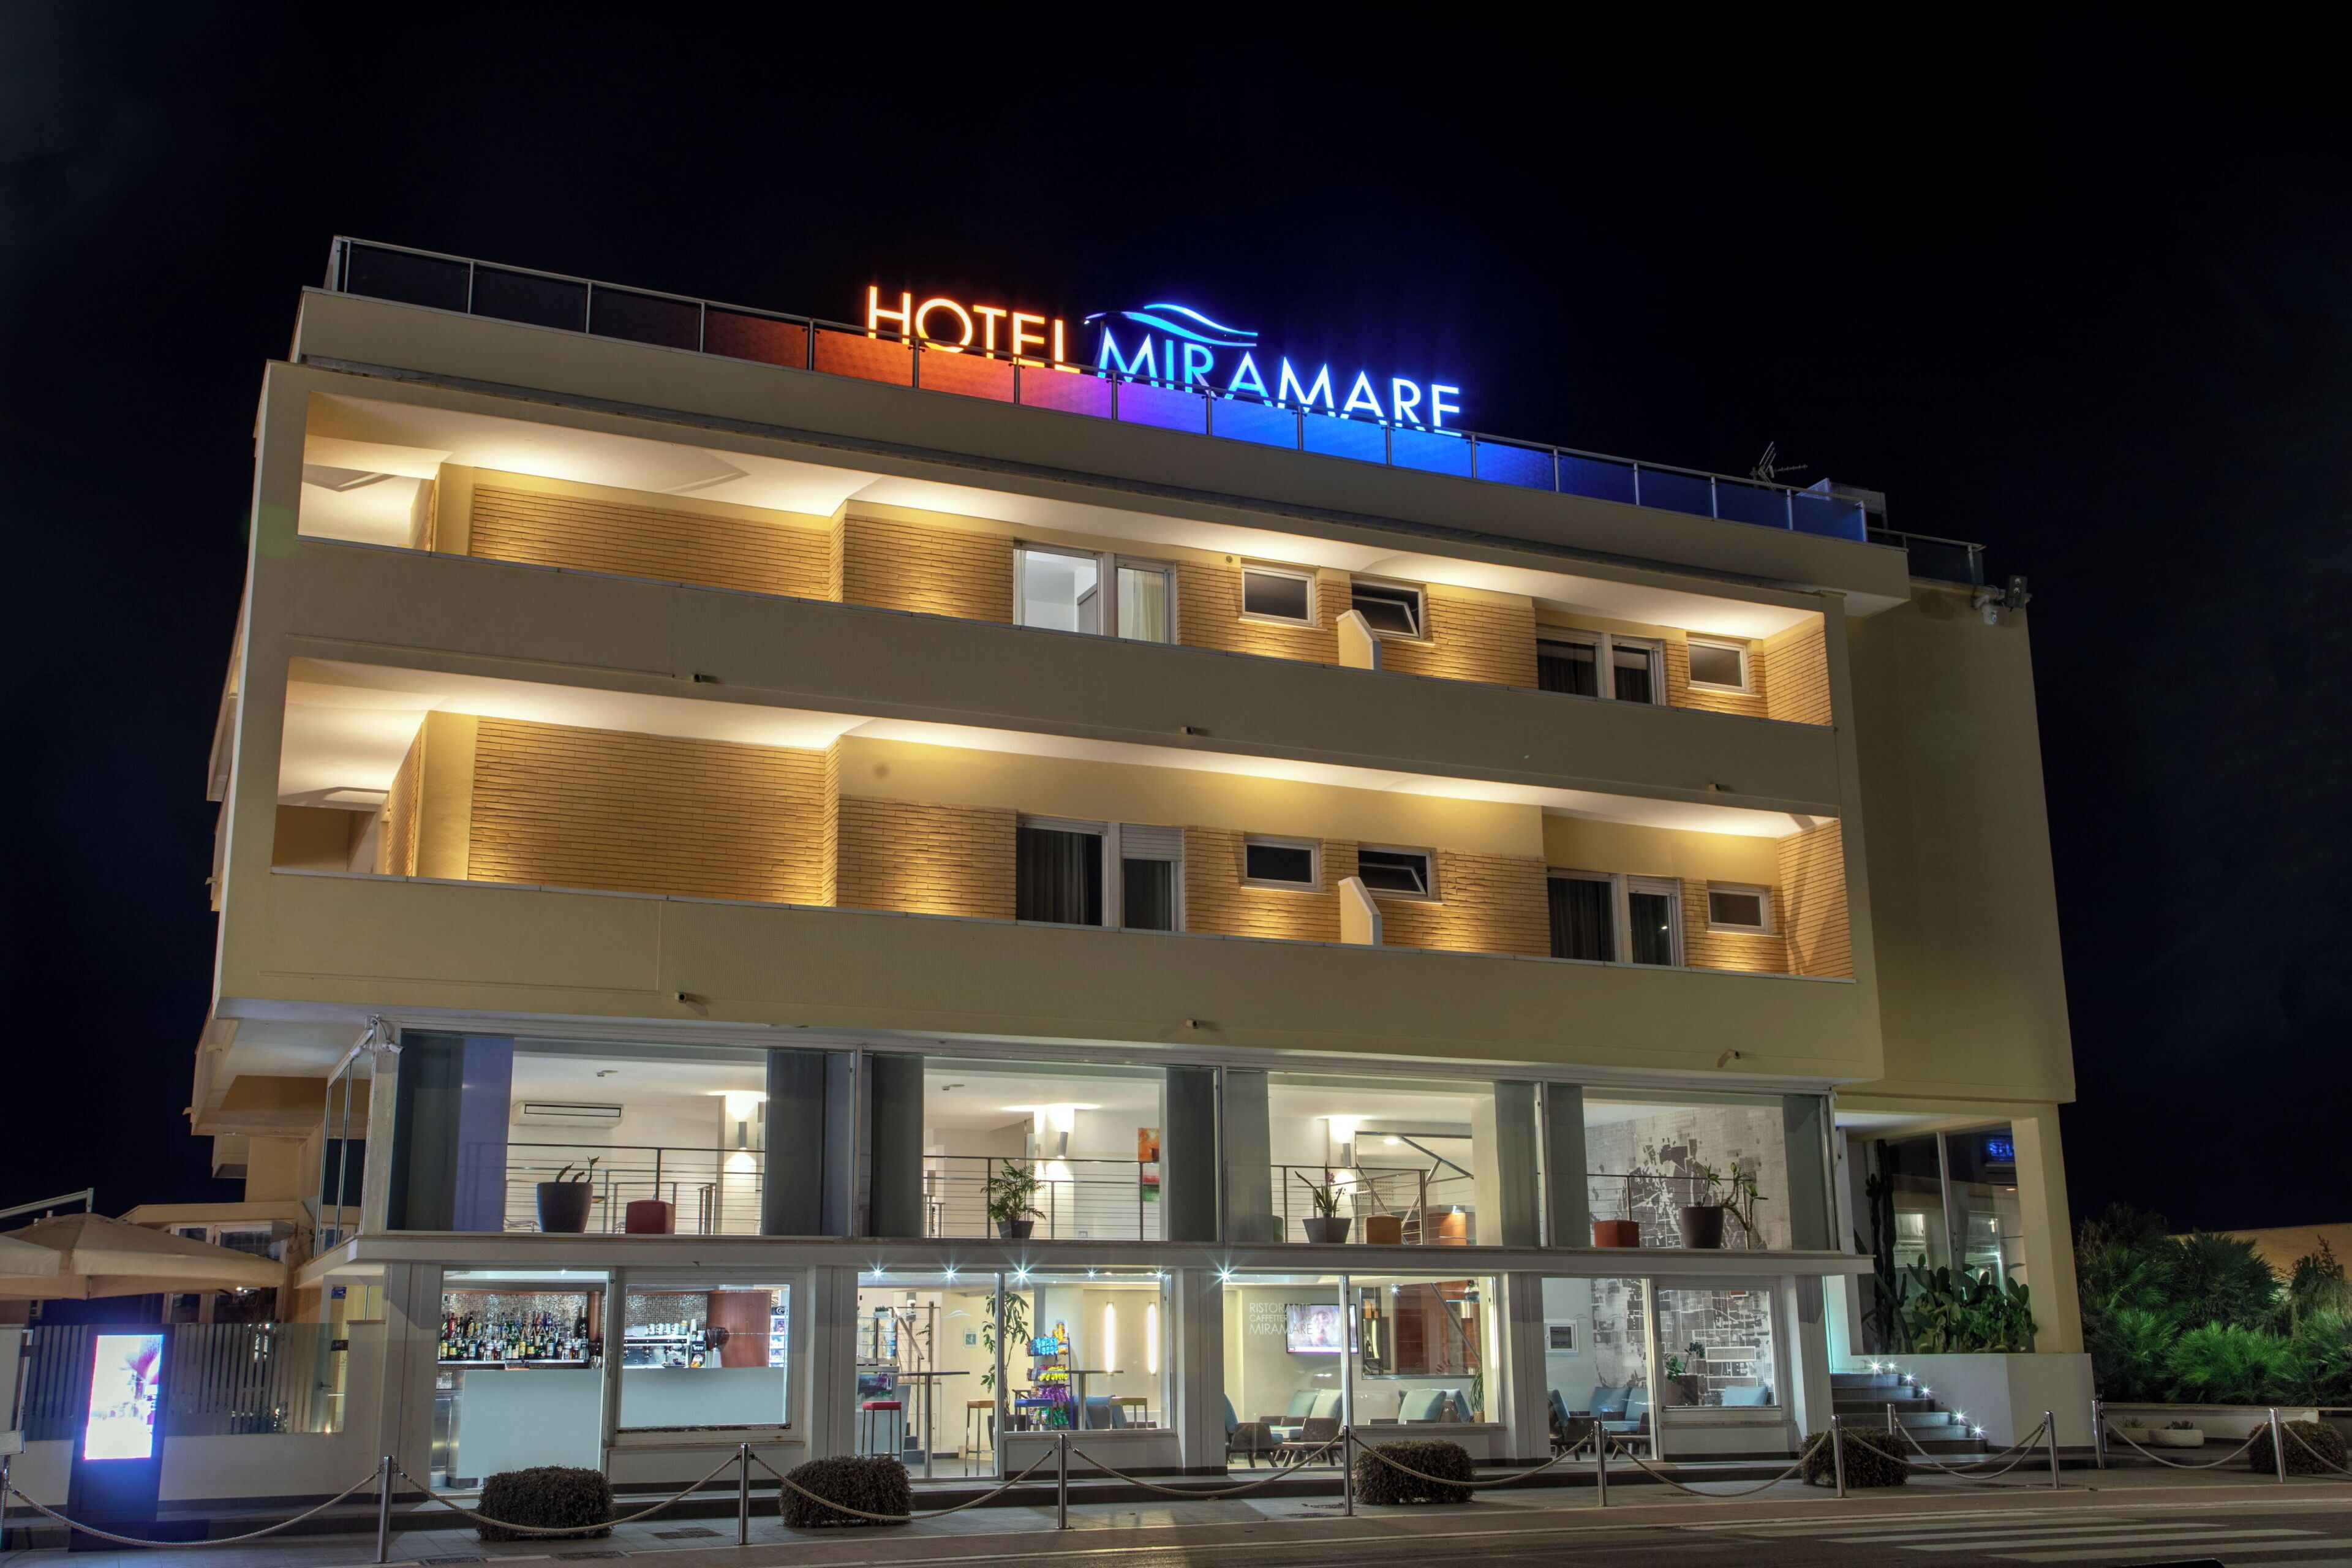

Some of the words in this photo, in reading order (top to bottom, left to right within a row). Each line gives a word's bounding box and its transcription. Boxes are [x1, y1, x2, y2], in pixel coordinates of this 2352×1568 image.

[867, 285, 1080, 374] HOTEL
[1096, 326, 1463, 437] MIRAMARE
[1249, 1303, 1311, 1314] RISTORANTE
[1249, 1314, 1294, 1322] CAFFETTER
[1248, 1323, 1313, 1335] MIRAMARE
